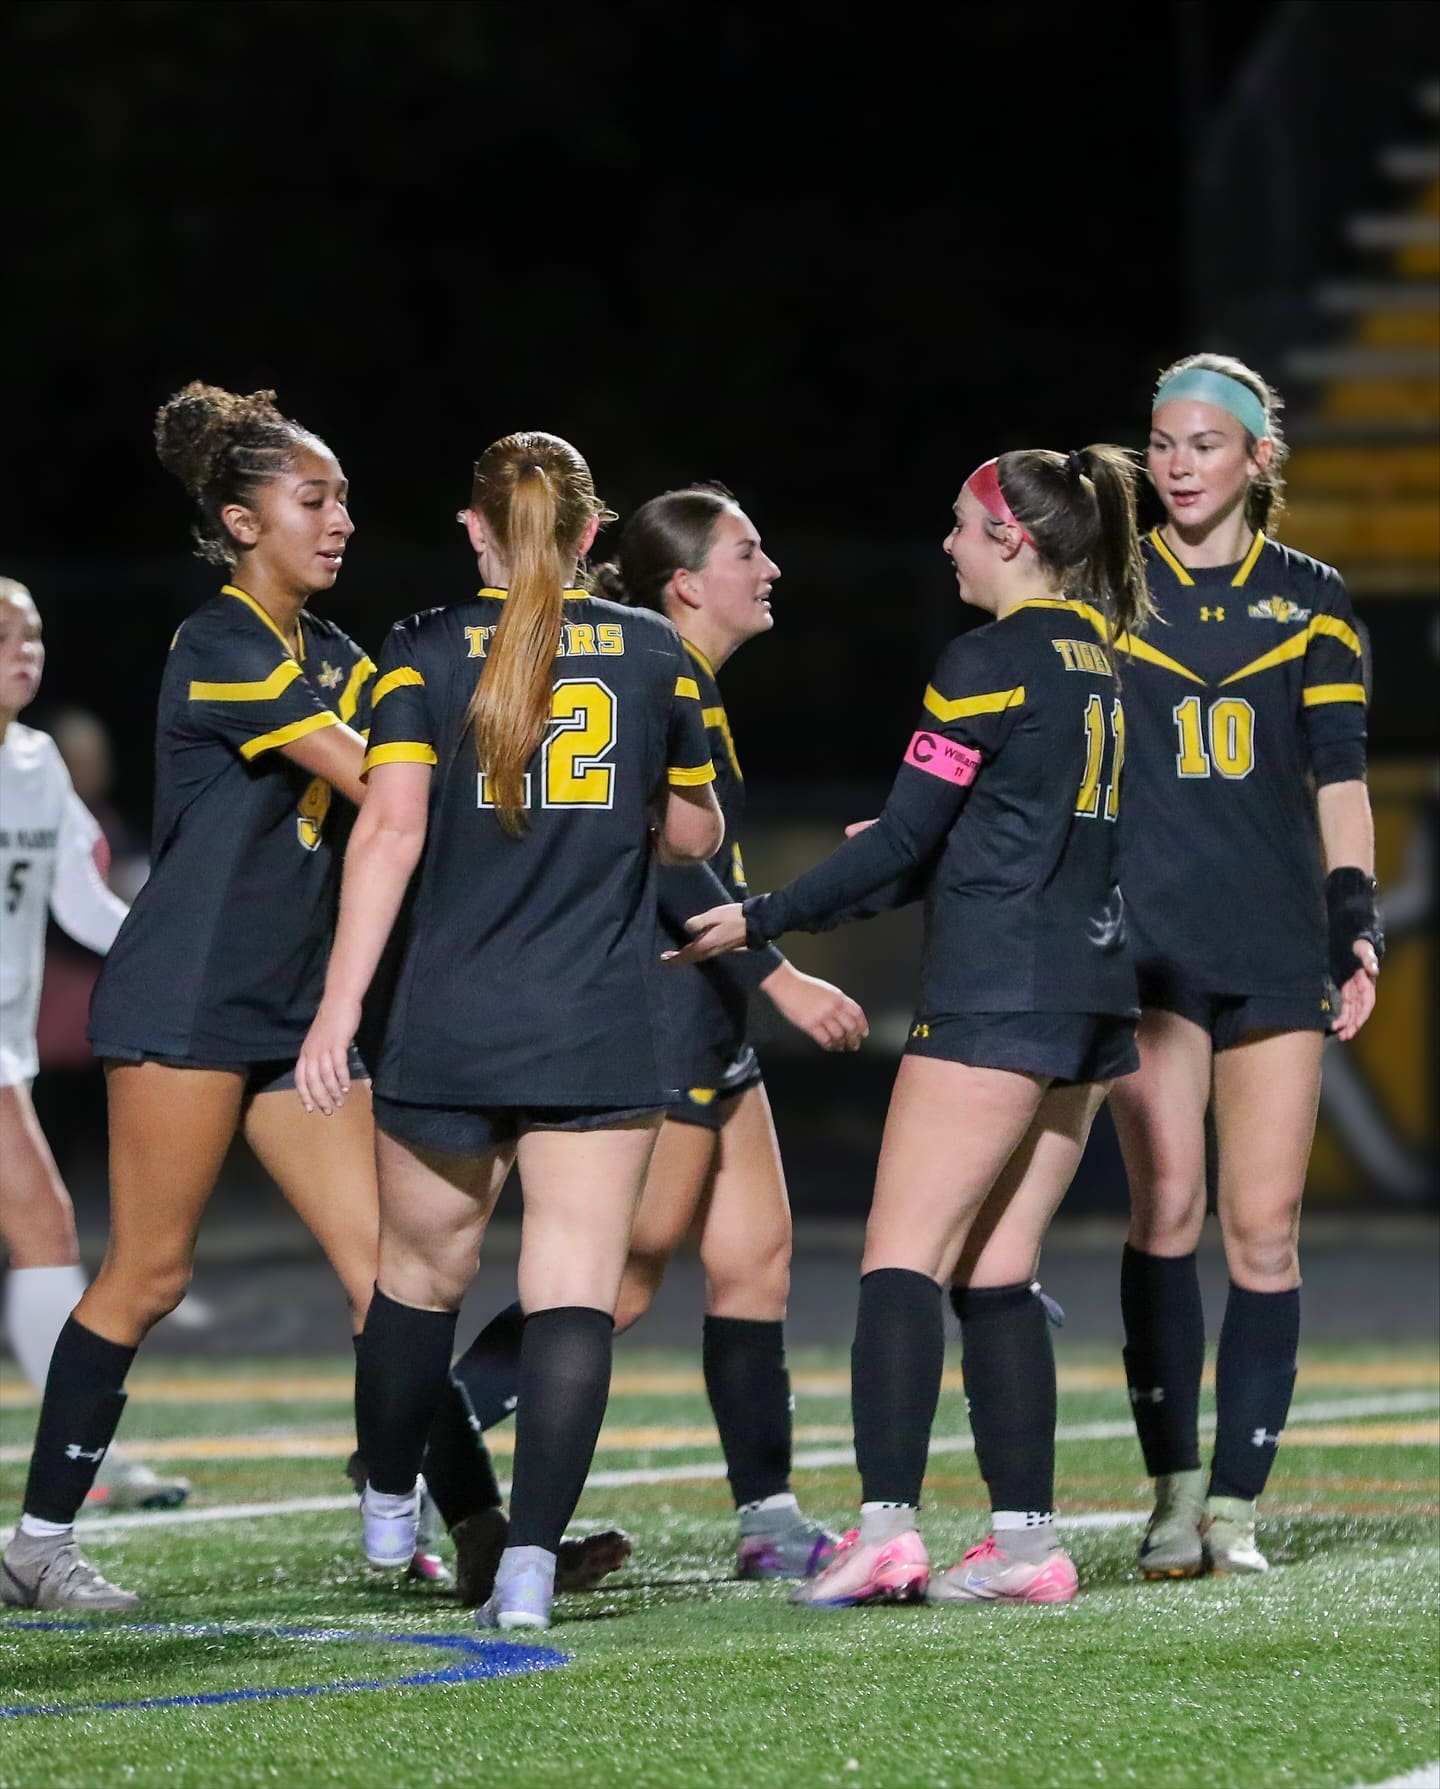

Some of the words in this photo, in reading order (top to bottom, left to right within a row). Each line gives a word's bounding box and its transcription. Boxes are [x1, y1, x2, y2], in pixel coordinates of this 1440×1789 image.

[464, 623, 625, 658] TRS
[1051, 638, 1113, 677] TIGE
[477, 678, 617, 809] 2
[913, 733, 937, 763] C
[1173, 696, 1255, 780] 10
[944, 745, 979, 770] William
[954, 766, 964, 777] 11
[6, 858, 31, 915] 5
